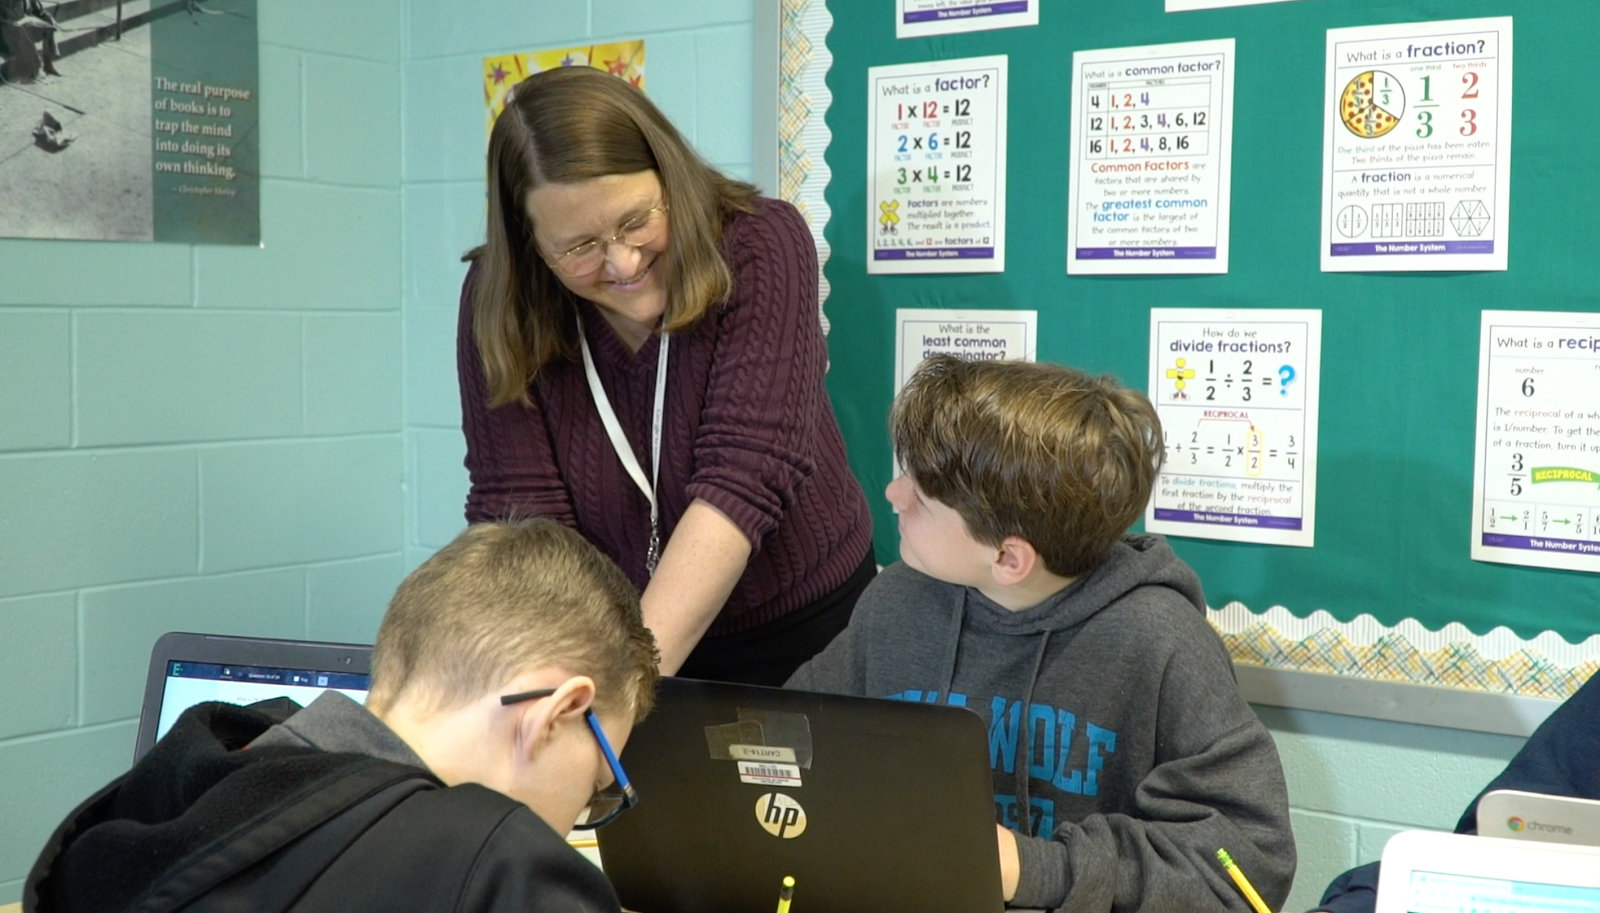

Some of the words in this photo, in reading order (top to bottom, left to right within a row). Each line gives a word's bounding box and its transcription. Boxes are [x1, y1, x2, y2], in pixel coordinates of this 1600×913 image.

[938, 10, 948, 18] The
[948, 9, 970, 17] Number
[972, 6, 992, 16] System
[1347, 51, 1377, 62] What
[1382, 49, 1391, 60] is
[1408, 40, 1485, 58] fraction?
[1126, 64, 1174, 76] common
[1178, 60, 1221, 73] factor?
[155, 77, 178, 91] The
[180, 82, 201, 94] real
[204, 85, 250, 100] purpose
[882, 85, 909, 96] What
[935, 74, 990, 92] factor?
[1420, 75, 1434, 102] 1
[1461, 72, 1478, 99] 2
[1092, 95, 1100, 108] 4
[1112, 95, 1118, 108] 1,
[1124, 94, 1136, 108] 2,
[1141, 92, 1150, 106] 4
[155, 98, 168, 110] of
[171, 100, 204, 114] books
[207, 103, 216, 115] is
[219, 106, 231, 117] to
[898, 104, 902, 120] 1
[923, 101, 938, 118] 12
[955, 98, 970, 116] 12
[155, 119, 178, 134] trap
[181, 120, 199, 133] the
[202, 123, 232, 137] mind
[1091, 118, 1102, 130] 12
[1112, 117, 1118, 131] 1,
[1124, 116, 1135, 130] 2,
[1141, 114, 1152, 129] 3,
[1157, 113, 1170, 128] 4,
[1176, 112, 1188, 127] 6,
[1194, 112, 1206, 126] 12
[1416, 111, 1433, 138] 3
[1460, 108, 1477, 136] 3
[156, 139, 179, 152] into
[182, 140, 215, 158] doing
[216, 144, 231, 156] its
[898, 134, 908, 152] 2
[928, 132, 938, 150] 6
[956, 131, 970, 148] 12
[1090, 140, 1102, 154] 16
[1111, 139, 1118, 154] 1,
[1124, 138, 1136, 153] 2,
[1140, 137, 1154, 152] 4,
[1158, 136, 1171, 152] 8,
[1176, 136, 1189, 150] 16
[1338, 146, 1352, 154] One
[156, 161, 181, 173] own
[184, 160, 237, 180] thinking.
[1092, 162, 1141, 173] Common
[1144, 160, 1190, 171] Factors
[898, 167, 906, 184] 3
[928, 166, 938, 183] 4
[956, 164, 971, 182] 12
[1126, 176, 1140, 184] that
[1161, 174, 1188, 182] shared
[1192, 174, 1200, 182] by
[1362, 172, 1411, 182] fraction
[1434, 171, 1474, 180] numerical
[1338, 188, 1370, 199] quantity
[1374, 188, 1390, 196] that
[1428, 185, 1451, 193] whole
[908, 199, 938, 208] Factors
[1102, 198, 1152, 212] greatest
[1155, 199, 1208, 208] common
[908, 210, 940, 220] multiplied
[1094, 212, 1130, 222] factor
[1158, 213, 1186, 222] largest
[1152, 249, 1175, 257] System
[1375, 244, 1387, 252] The
[1388, 244, 1418, 252] Number
[1420, 244, 1446, 252] System
[939, 324, 963, 334] What
[976, 324, 990, 334] the
[1202, 328, 1223, 338] How
[1228, 328, 1240, 338] do
[923, 336, 950, 346] least
[954, 338, 1006, 348] common
[1170, 340, 1213, 352] divide
[1218, 340, 1291, 353] fractions?
[1497, 337, 1528, 348] What
[1534, 338, 1542, 348] is
[1243, 360, 1252, 374] 2
[1278, 364, 1296, 396] ?
[1206, 386, 1215, 400] 2
[1242, 387, 1251, 401] 3
[1522, 377, 1534, 398] 6
[1204, 410, 1248, 418] RECIPROCAL
[1495, 407, 1510, 416] The
[1515, 408, 1560, 419] reciprocal
[1565, 411, 1574, 419] of
[1553, 426, 1563, 434] To
[1567, 426, 1582, 438] get
[1493, 439, 1502, 447] of
[1516, 440, 1552, 450] fraction,
[1558, 442, 1576, 450] turn
[1580, 442, 1586, 452] it
[1512, 453, 1523, 472] 3
[1535, 470, 1593, 482] RECIPROCAL
[1172, 478, 1195, 486] divide
[1200, 479, 1237, 490] fractions,
[1242, 482, 1275, 492] multiply
[1280, 484, 1292, 492] the
[1510, 478, 1522, 496] 5
[1162, 488, 1178, 497] first
[1182, 490, 1214, 500] fraction
[1217, 492, 1226, 502] by
[1231, 492, 1244, 500] the
[1248, 494, 1292, 504] reciprocal
[1206, 514, 1232, 522] Number
[1234, 516, 1258, 525] System
[1530, 540, 1544, 548] The
[1545, 540, 1576, 550] Number
[1578, 543, 1600, 552] Syste
[988, 695, 1117, 796] WOLF
[764, 793, 799, 838] hp
[1527, 821, 1573, 836] chrome
